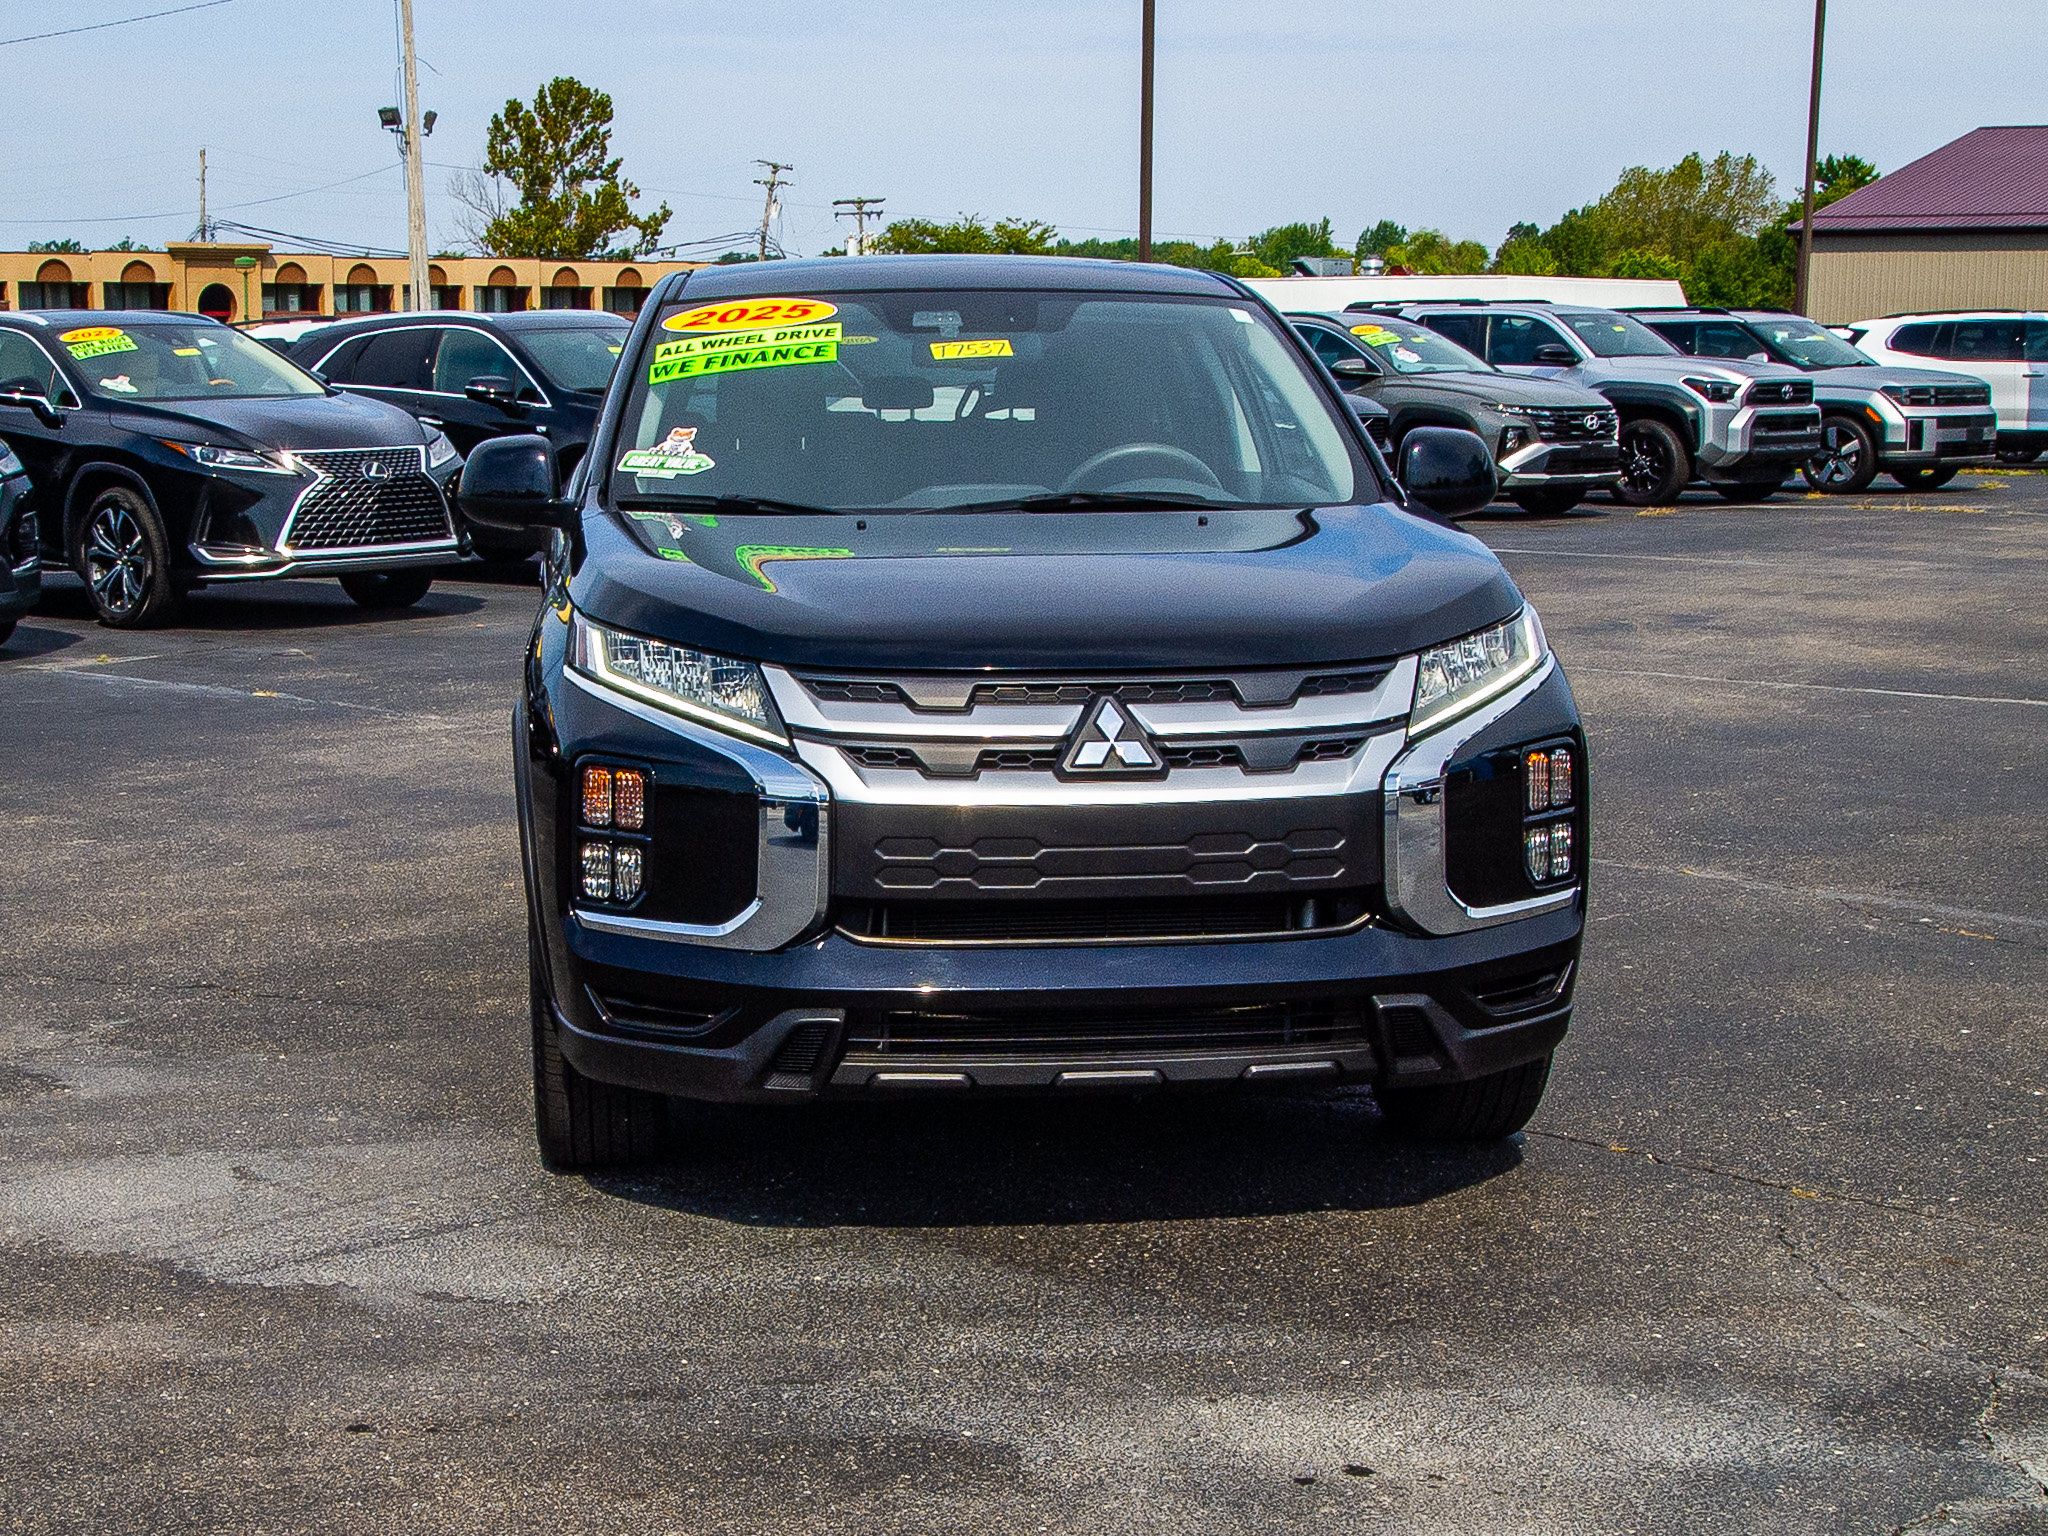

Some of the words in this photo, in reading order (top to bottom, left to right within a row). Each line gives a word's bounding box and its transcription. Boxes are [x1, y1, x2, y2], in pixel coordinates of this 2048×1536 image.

[681, 304, 816, 329] 2025
[660, 343, 695, 358] ALL
[701, 334, 766, 350] WHEEL
[774, 327, 838, 341] DRIVE
[935, 342, 1005, 358] T7537
[653, 360, 697, 379] WE
[703, 344, 829, 370] FINANCE
